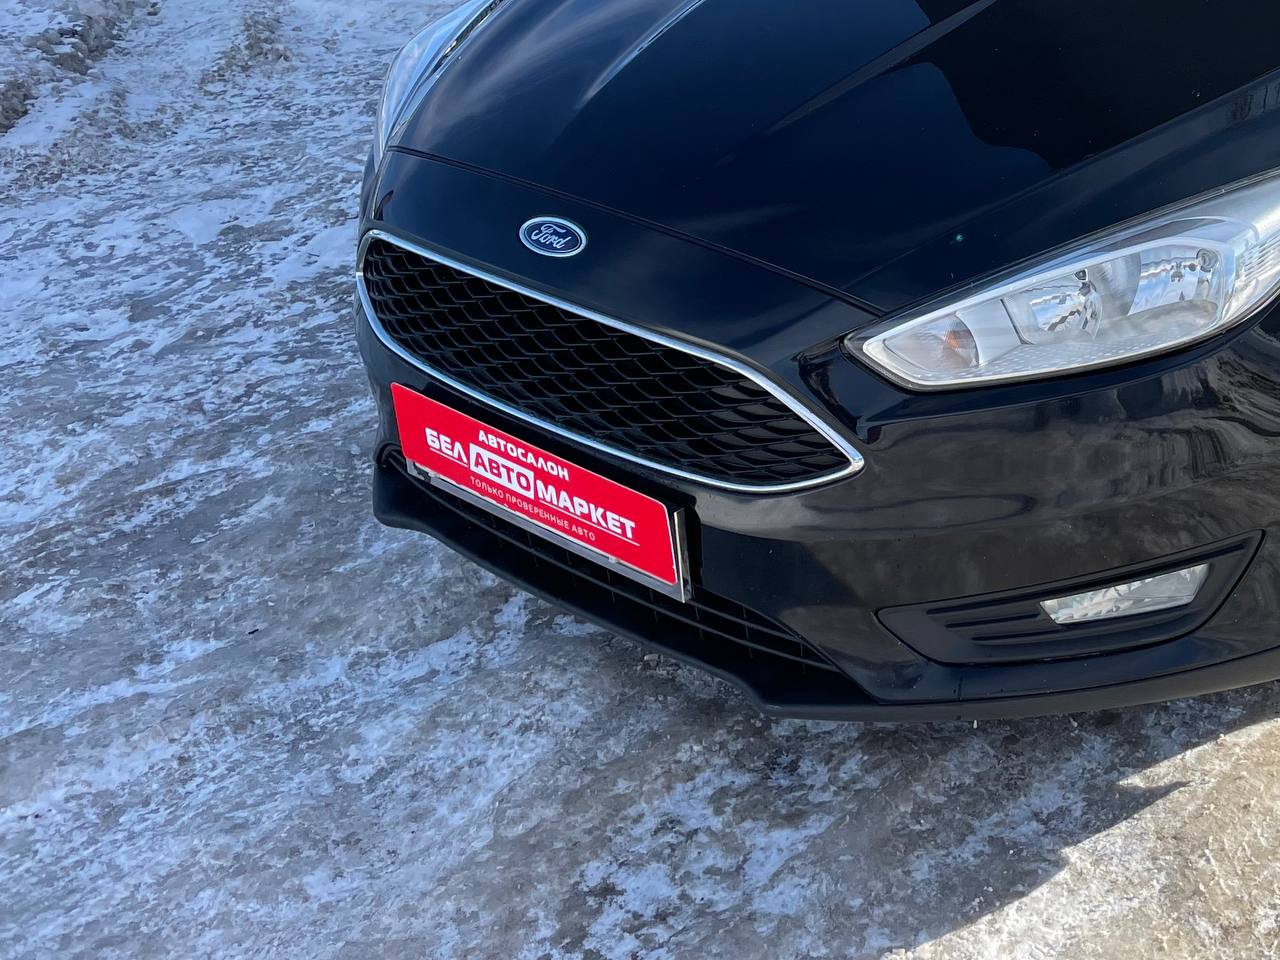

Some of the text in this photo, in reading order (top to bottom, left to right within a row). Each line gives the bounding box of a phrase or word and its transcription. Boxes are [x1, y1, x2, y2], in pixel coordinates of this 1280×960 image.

[530, 223, 572, 249] Ford
[425, 427, 636, 539] БЕЛ АВТО МАРКЕТ
[478, 429, 569, 481] АВТОСАЛОН
[470, 475, 596, 541] ТОЛЬКО ПРОВЕРЕННЫЕ АВТО
